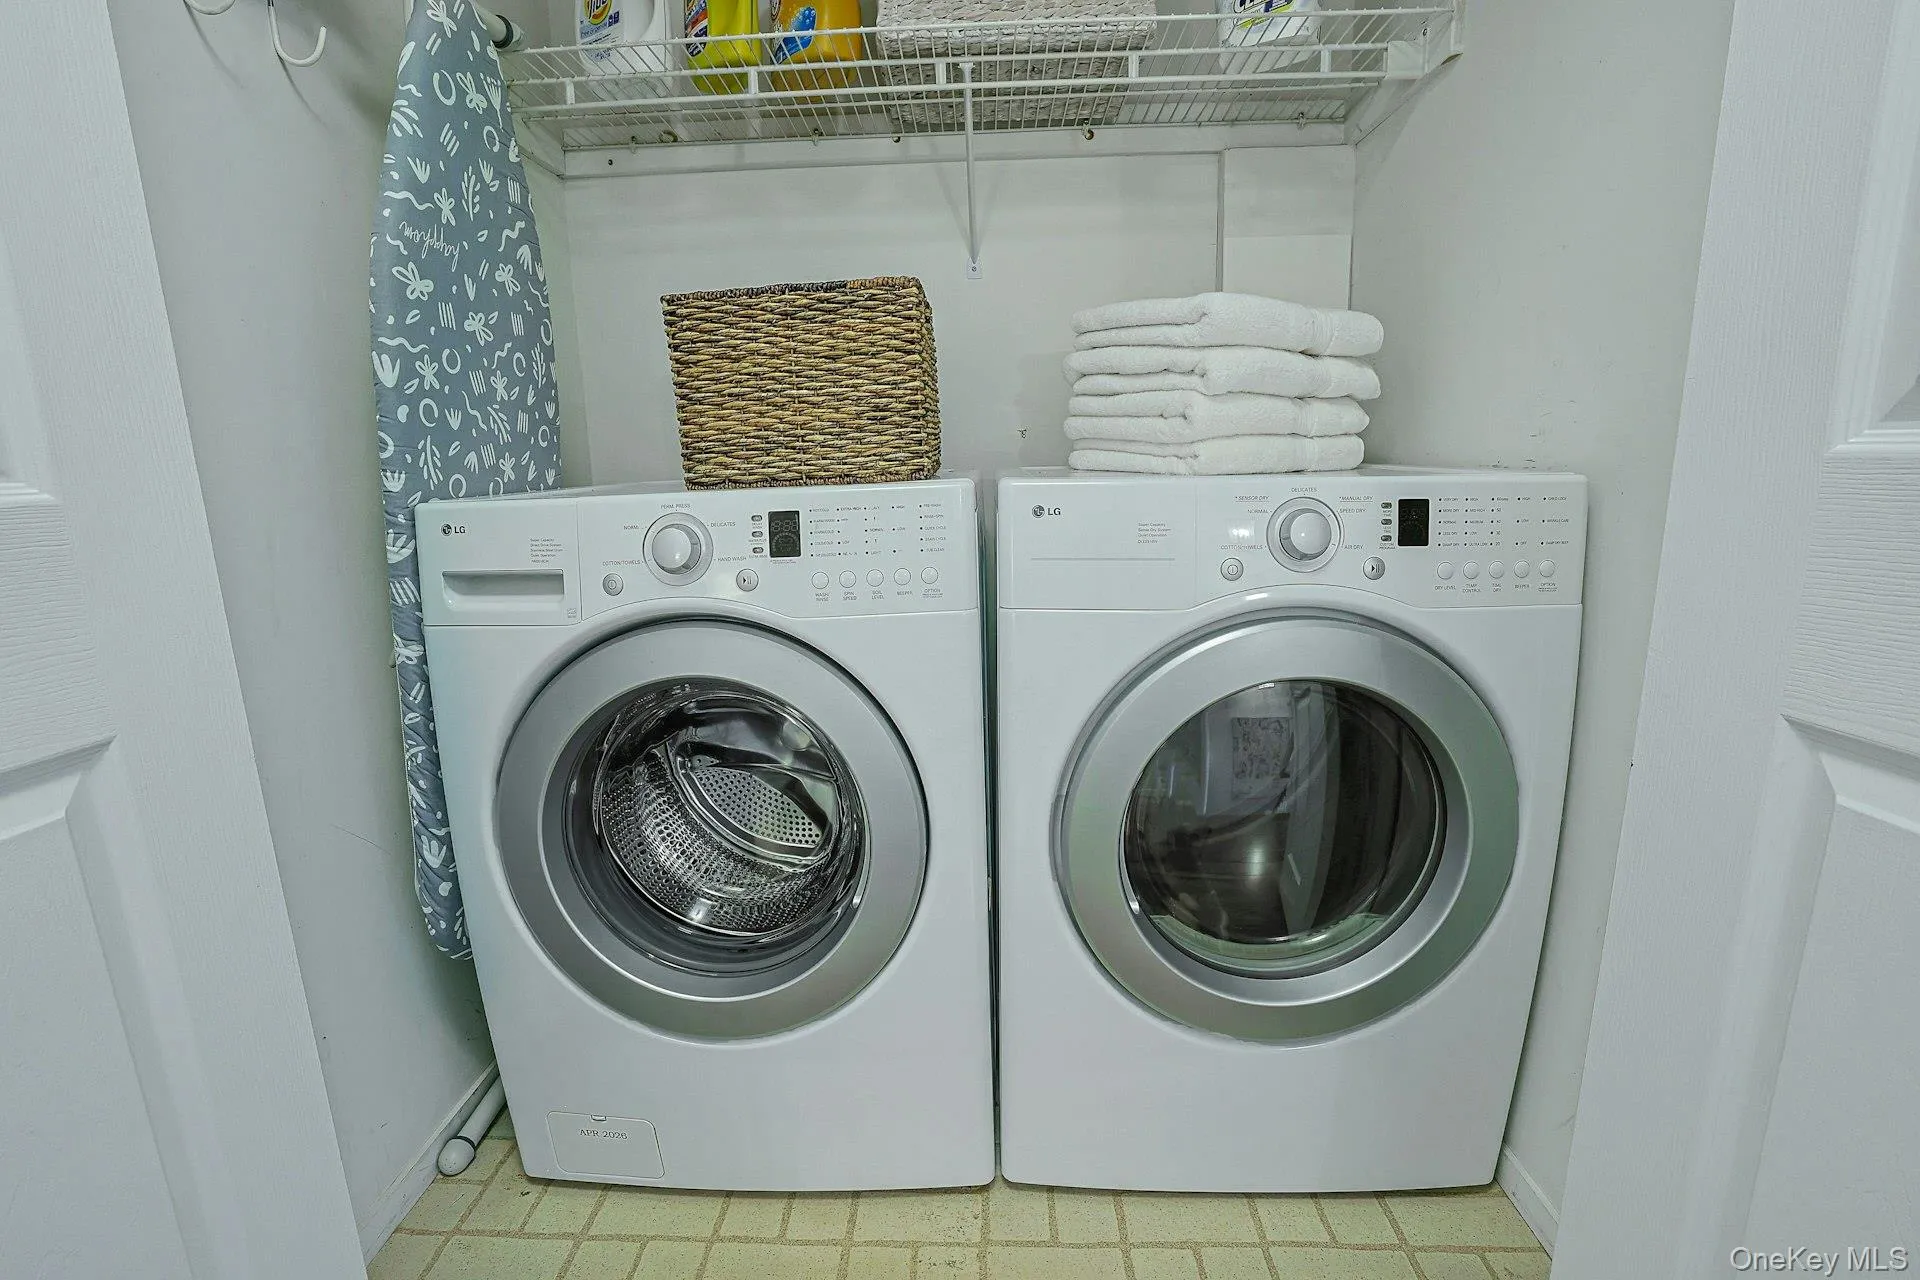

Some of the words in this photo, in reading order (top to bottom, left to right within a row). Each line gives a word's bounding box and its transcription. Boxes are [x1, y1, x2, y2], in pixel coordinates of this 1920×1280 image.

[1047, 507, 1061, 516] LG
[454, 526, 466, 534] LG
[580, 1129, 600, 1137] APR
